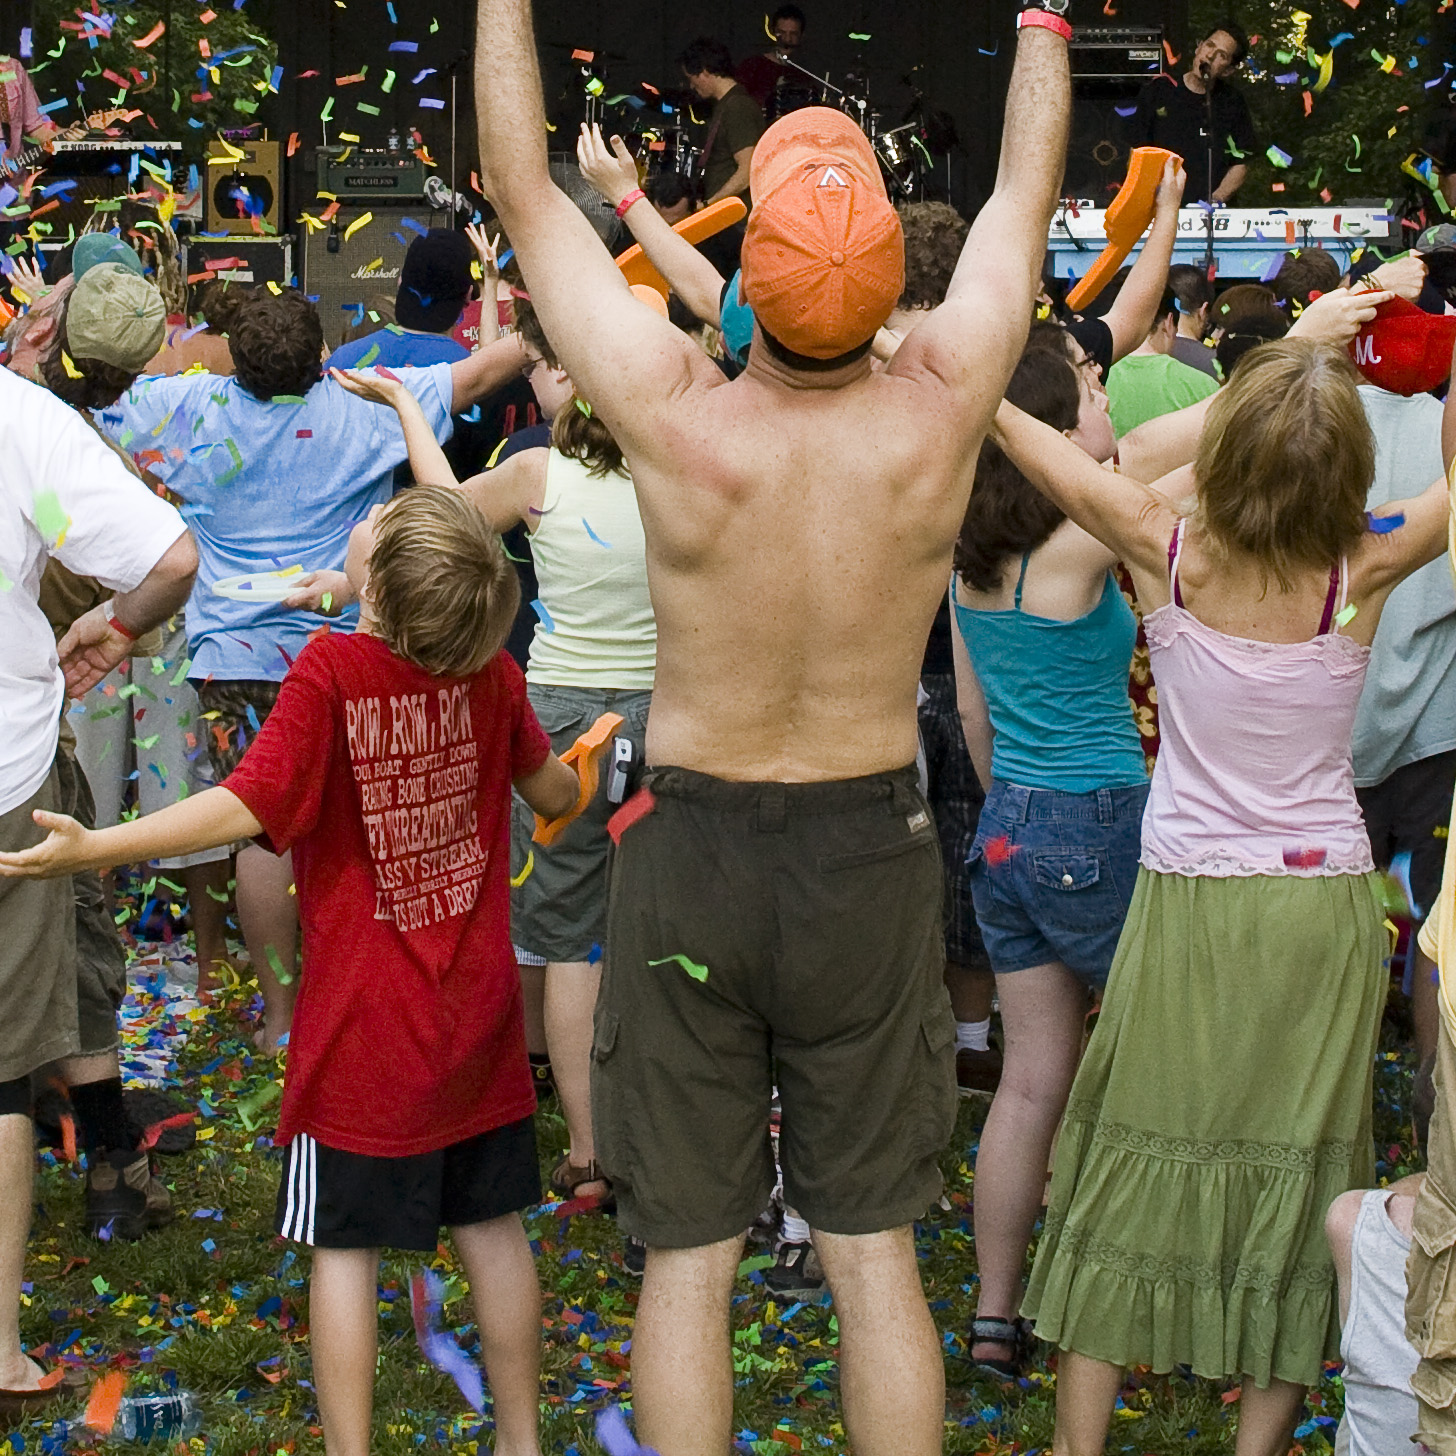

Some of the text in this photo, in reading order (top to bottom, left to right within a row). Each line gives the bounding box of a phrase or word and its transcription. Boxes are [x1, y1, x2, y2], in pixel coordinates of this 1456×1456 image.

[348, 178, 394, 186] MATCHLESS
[351, 265, 400, 280] Marshall
[345, 696, 388, 761] ROW,
[389, 693, 435, 756] ROW,
[431, 893, 445, 923] A
